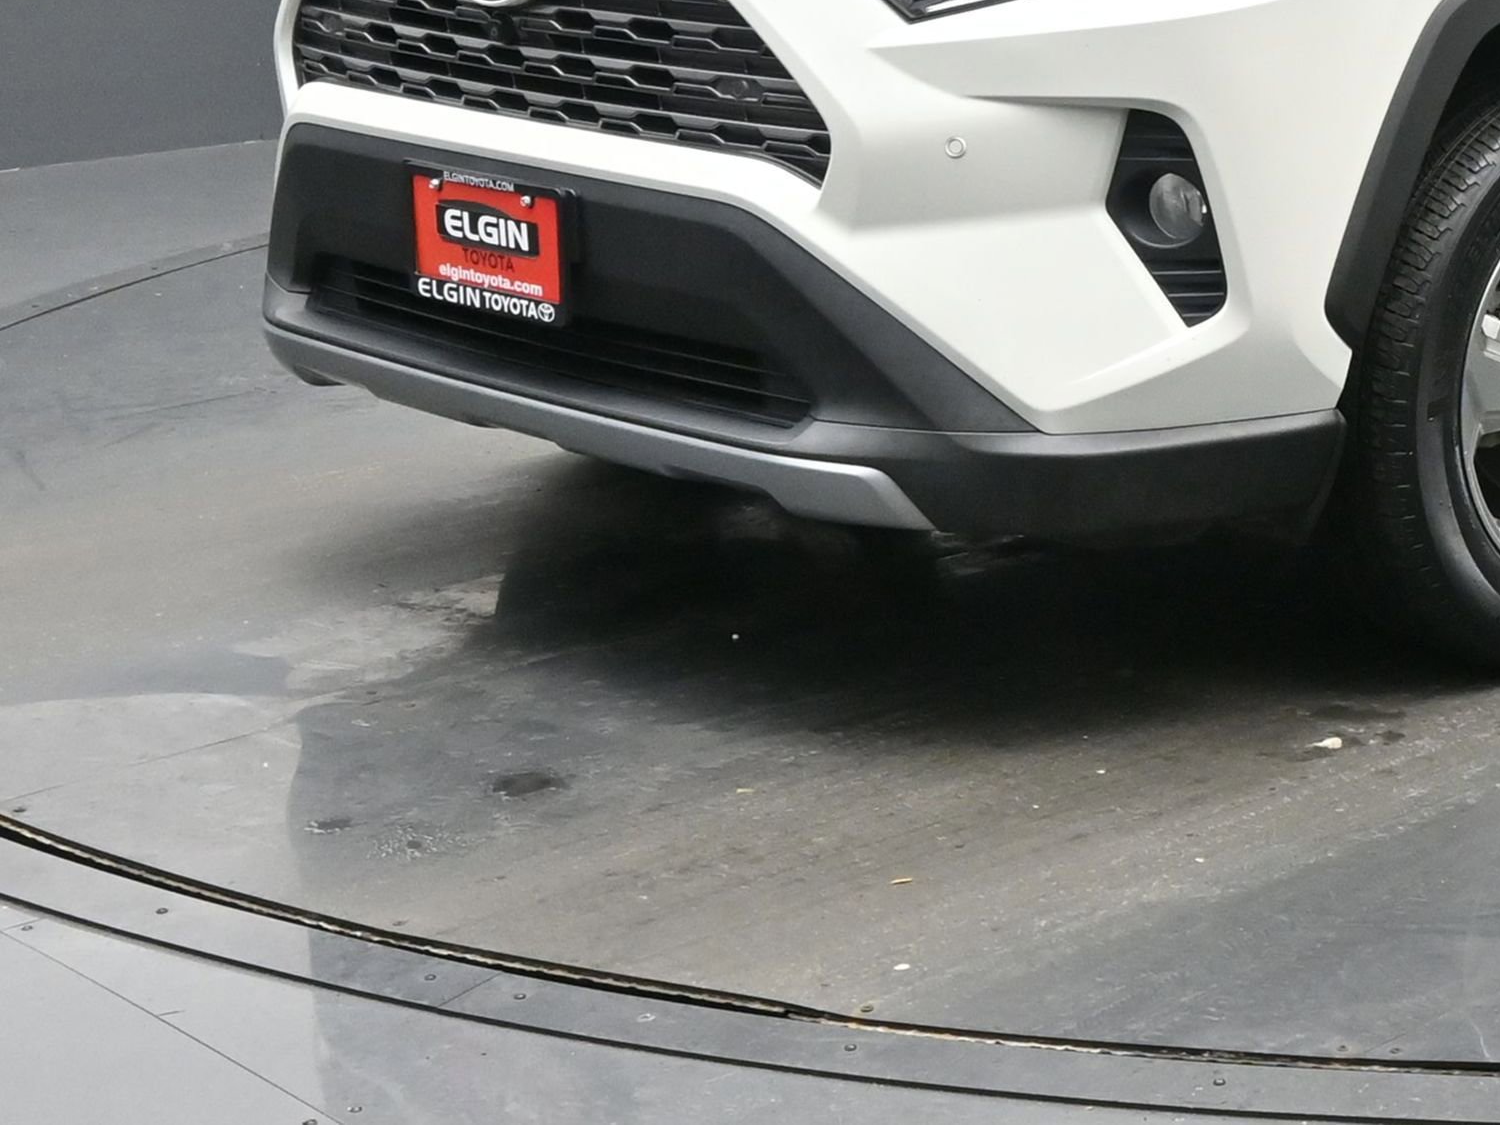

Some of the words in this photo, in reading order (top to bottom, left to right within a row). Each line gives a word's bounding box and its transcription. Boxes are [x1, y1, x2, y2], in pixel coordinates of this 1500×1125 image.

[443, 171, 515, 192] ELGINTOYOTA.COM
[444, 208, 529, 252] ELGIN
[462, 248, 515, 272] TOYOTA
[438, 263, 543, 296] elgintoyota.com
[417, 277, 481, 308] ELGIN
[482, 291, 538, 319] TOYOTA
